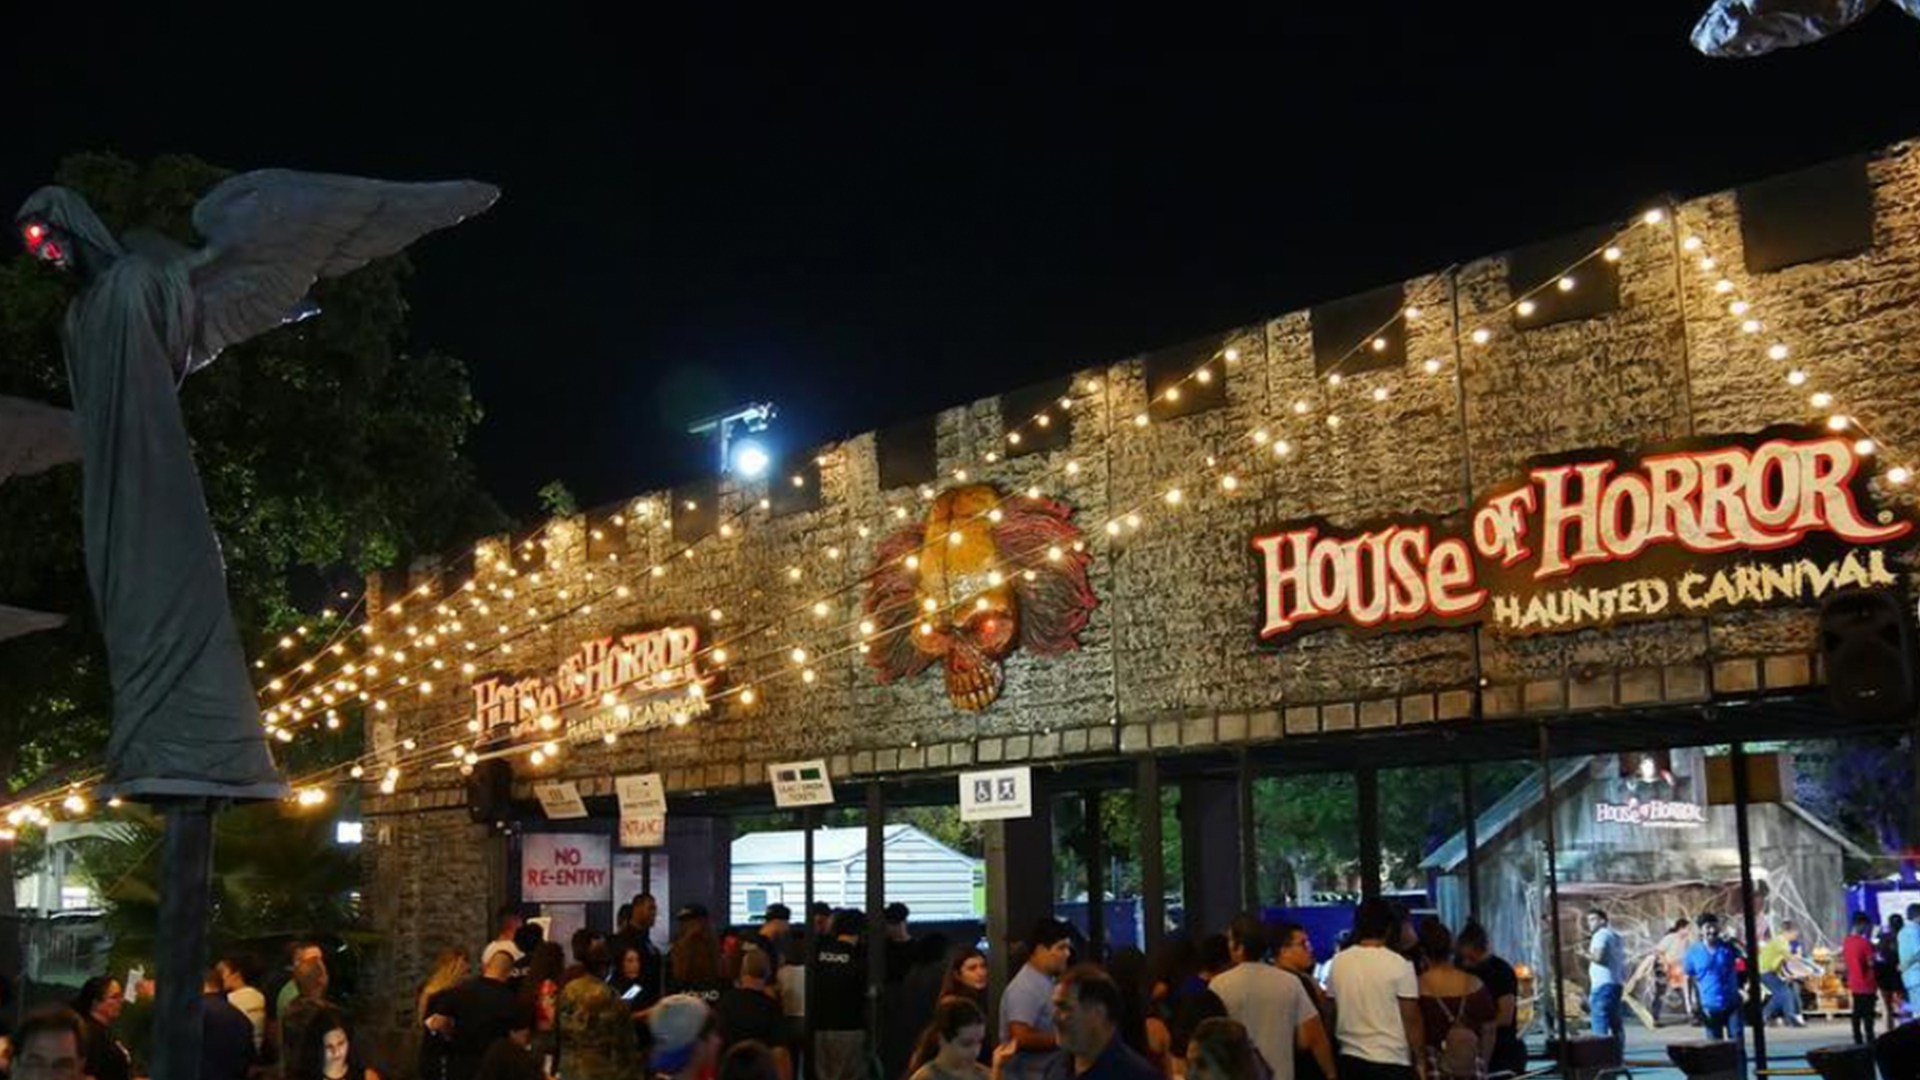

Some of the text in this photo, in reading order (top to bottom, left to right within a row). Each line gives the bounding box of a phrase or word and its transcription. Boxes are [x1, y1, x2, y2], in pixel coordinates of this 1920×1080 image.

[1472, 483, 1538, 567] OF
[1531, 437, 1912, 580] HORROR
[1492, 548, 1898, 629] HAUNTED CARNIVAL
[581, 625, 716, 707] HORROR
[527, 868, 606, 887] RE-ENTRY
[554, 848, 581, 866] NO
[818, 952, 849, 963] SQUAD
